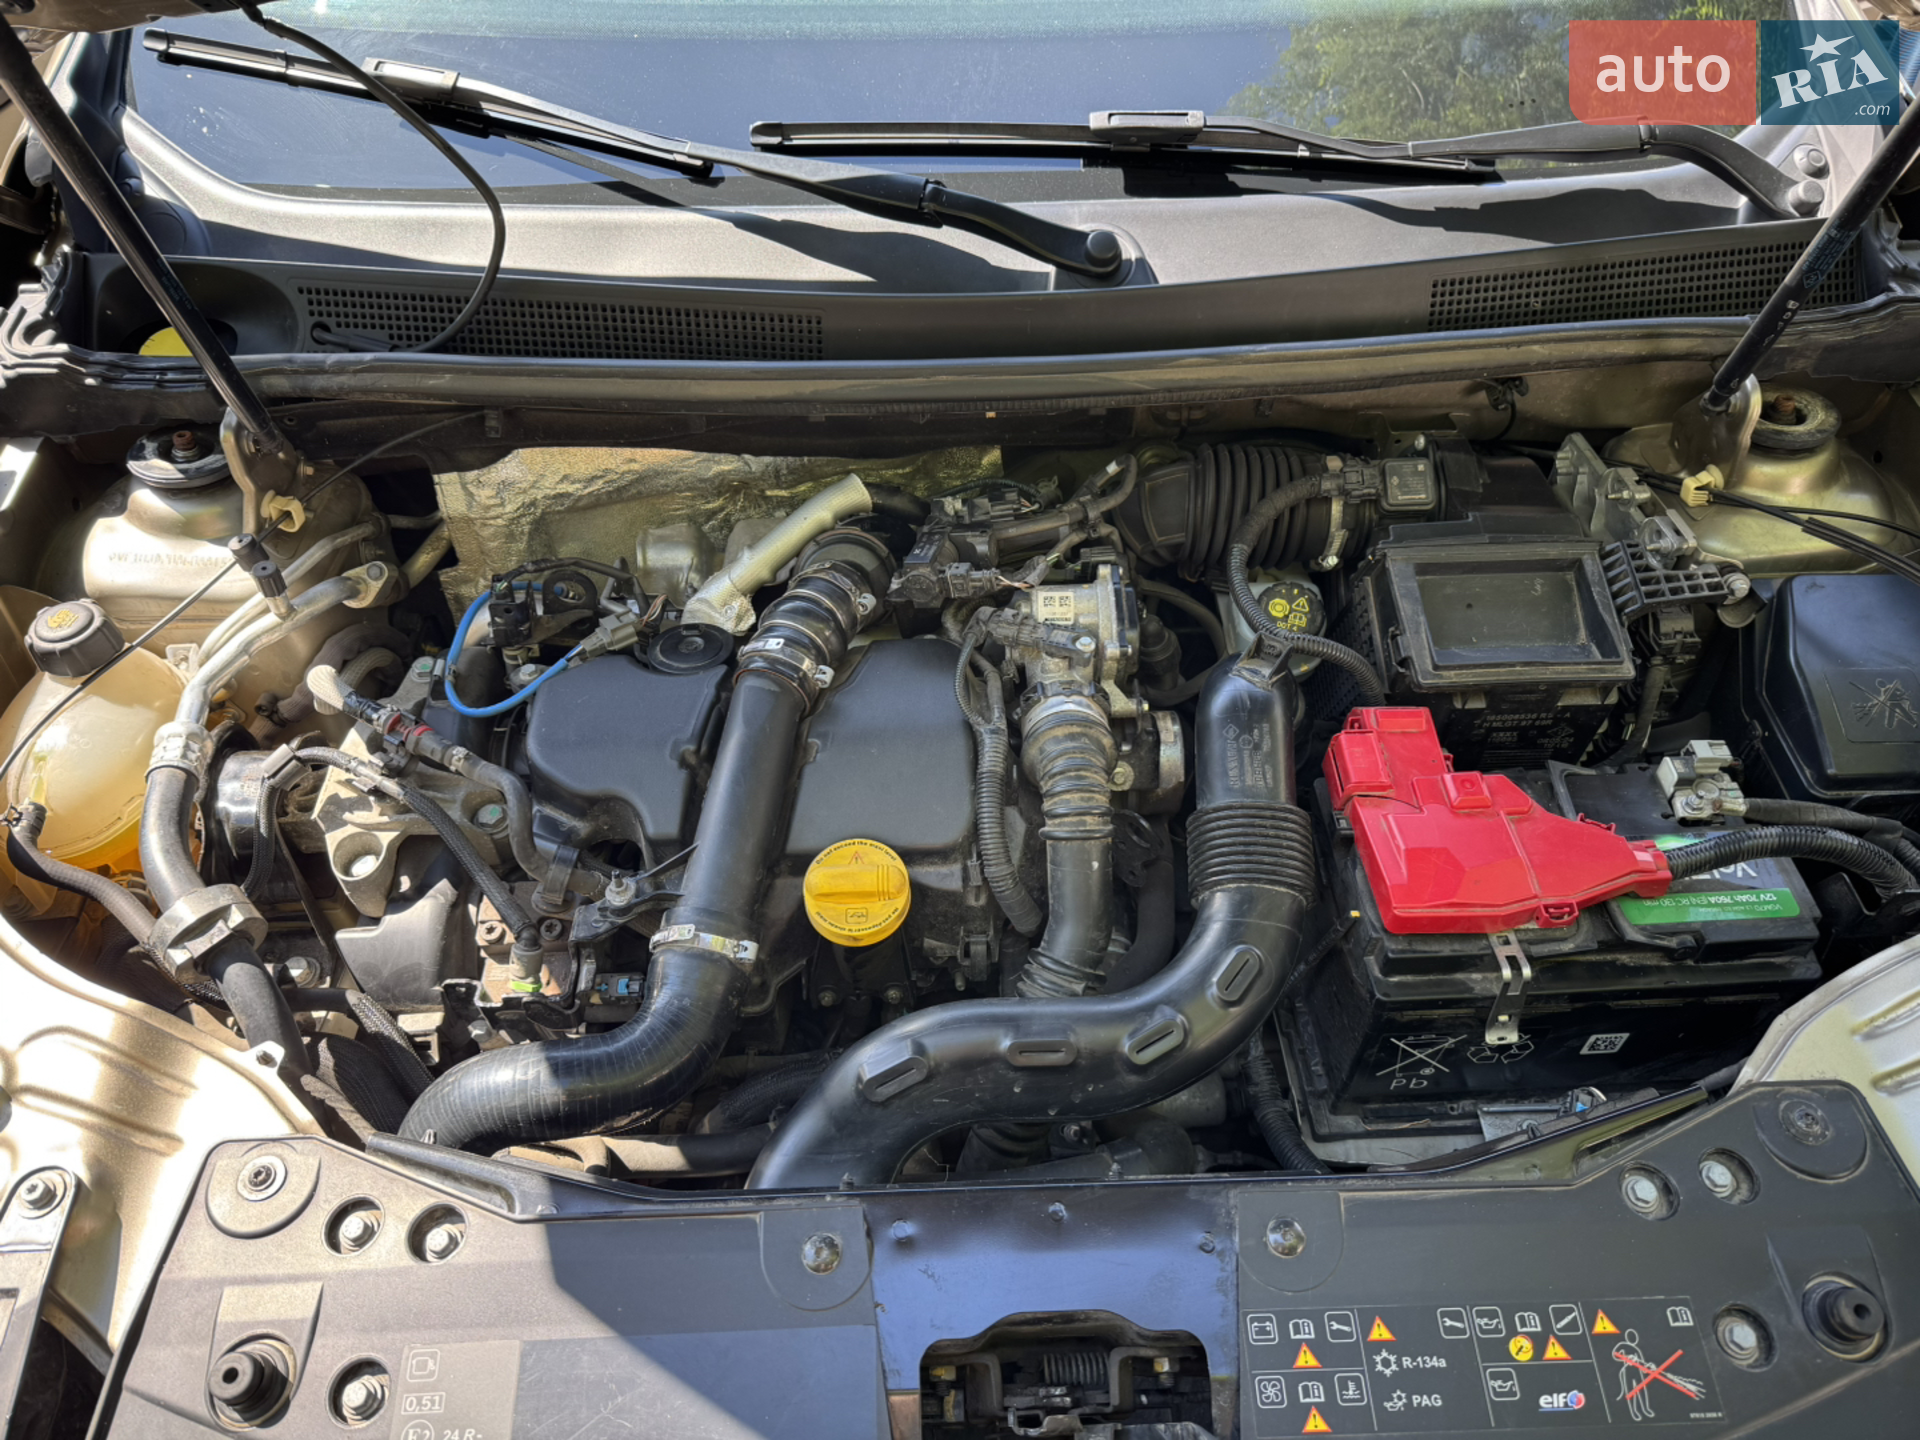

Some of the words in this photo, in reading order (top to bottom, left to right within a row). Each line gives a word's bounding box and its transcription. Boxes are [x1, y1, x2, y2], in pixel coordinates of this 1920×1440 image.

[833, 841, 856, 851] exceed
[883, 848, 897, 861] level
[1660, 898, 1675, 906] 130
[1676, 897, 1690, 905] RC
[1707, 895, 1733, 904] 760A
[1733, 893, 1758, 902] 70Ah
[1760, 893, 1777, 901] 12V
[1390, 1077, 1428, 1090] Pb
[1402, 1356, 1447, 1369] R-134a
[405, 1395, 442, 1413] 0,51
[1412, 1394, 1443, 1408] PAG
[1538, 1393, 1568, 1409] elf
[443, 1428, 460, 1440] 24
